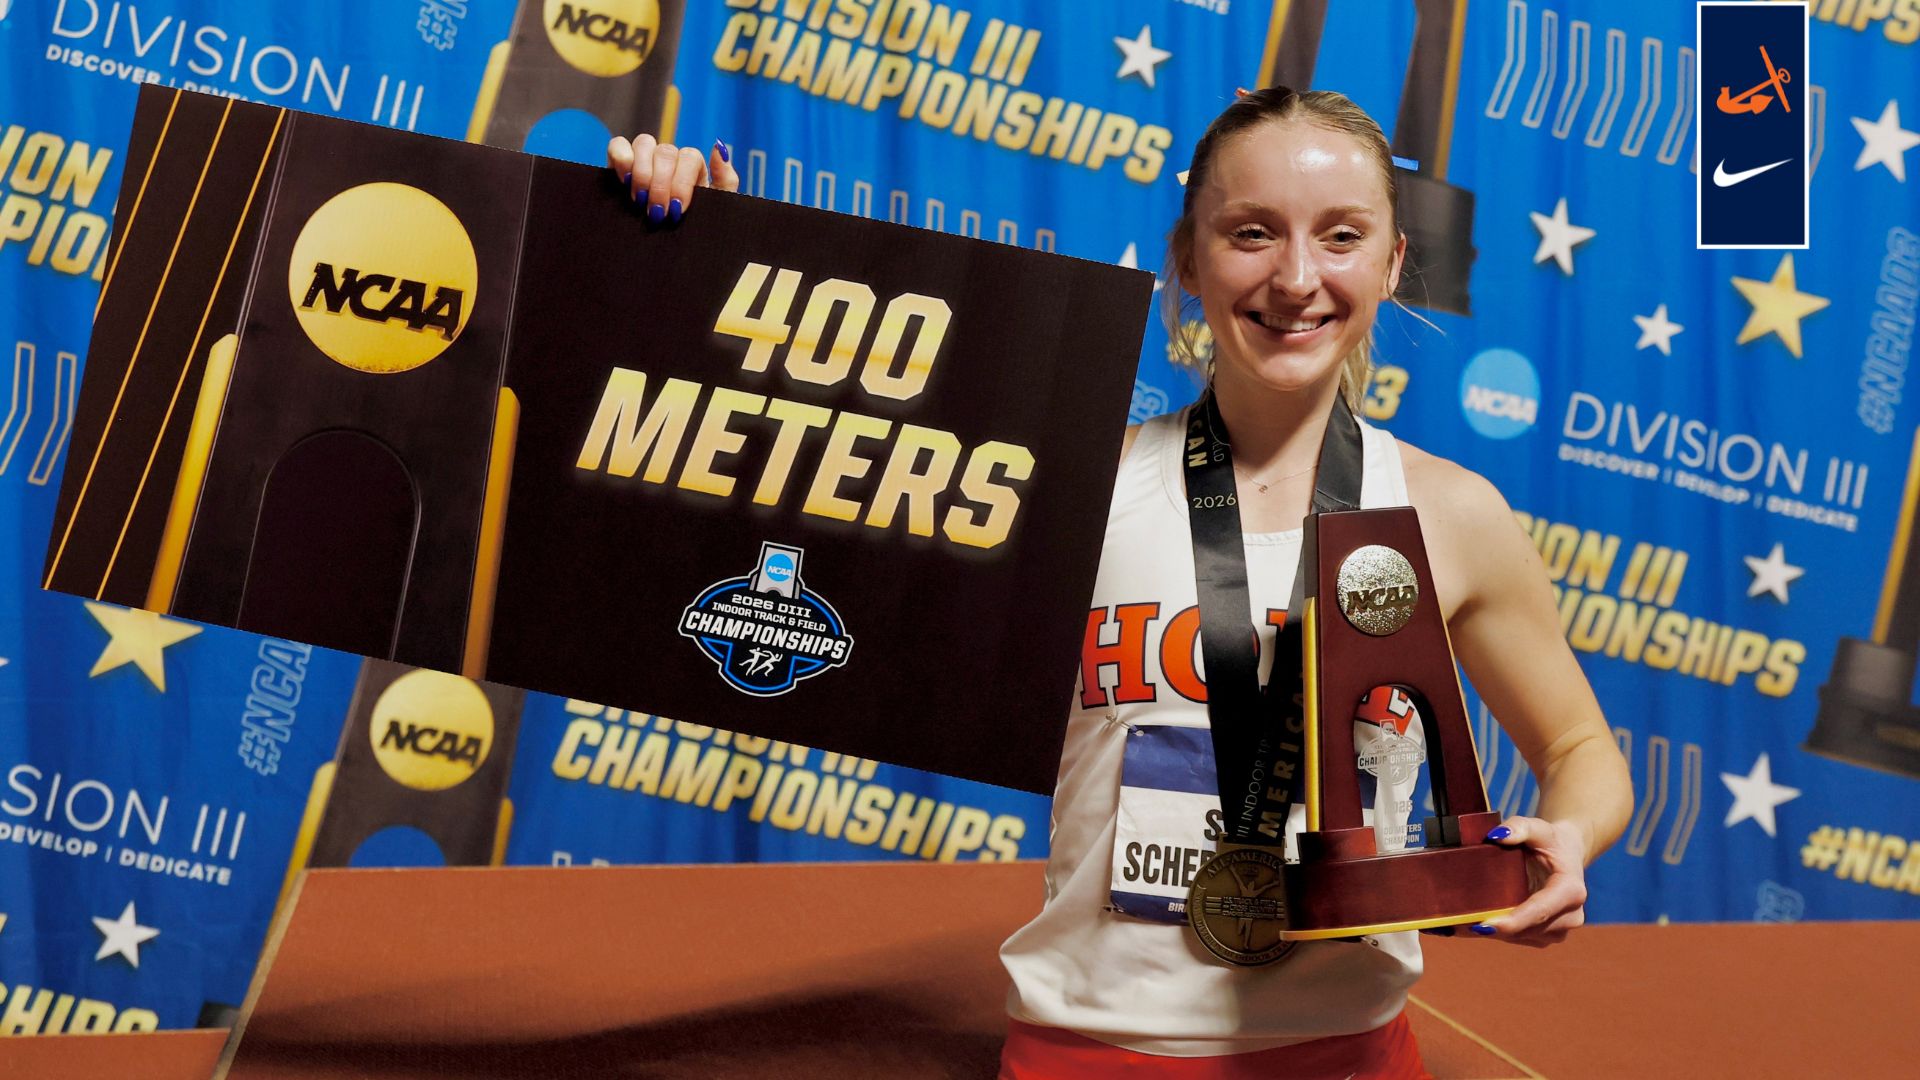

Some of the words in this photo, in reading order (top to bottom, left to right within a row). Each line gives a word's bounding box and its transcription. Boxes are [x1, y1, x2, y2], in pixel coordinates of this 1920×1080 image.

[553, 4, 650, 58] NCAA
[970, 18, 1041, 87] III
[46, 44, 161, 86] DISCOVER
[52, 0, 350, 111] DIVISION
[371, 74, 424, 131] III
[712, 11, 1173, 184] CHAMPIONSHIPS
[0, 124, 113, 208] ION
[0, 194, 117, 281] PIO
[303, 262, 464, 341] NCAA
[713, 262, 953, 400] 400
[1462, 385, 1538, 425] NCAA
[575, 366, 1036, 549] METERS
[1563, 391, 1808, 494] DIVISION
[1824, 456, 1868, 509] III
[1193, 493, 1237, 508] 2026
[1558, 443, 1659, 481] DISCOVER
[1674, 470, 1750, 504] DEVELOP
[1766, 495, 1858, 532] DEDICATE
[767, 565, 792, 577] NCAA
[1346, 584, 1417, 616] NCAA
[1619, 542, 1689, 608] III
[685, 611, 847, 659] CHAMPIONSHIPS
[712, 601, 752, 617] INDOOR
[754, 610, 787, 624] TRACK
[788, 617, 797, 626] &
[797, 620, 827, 632] FIELD
[731, 593, 774, 611] 2026
[778, 603, 812, 618] DIII
[1551, 584, 1806, 698] IONSHIPS
[379, 720, 484, 770] NCAA
[552, 717, 1026, 863] CHAMPIONSHIPS
[0, 822, 98, 857] DEVELOP
[119, 848, 232, 886] DEDICATE
[191, 804, 246, 860] III
